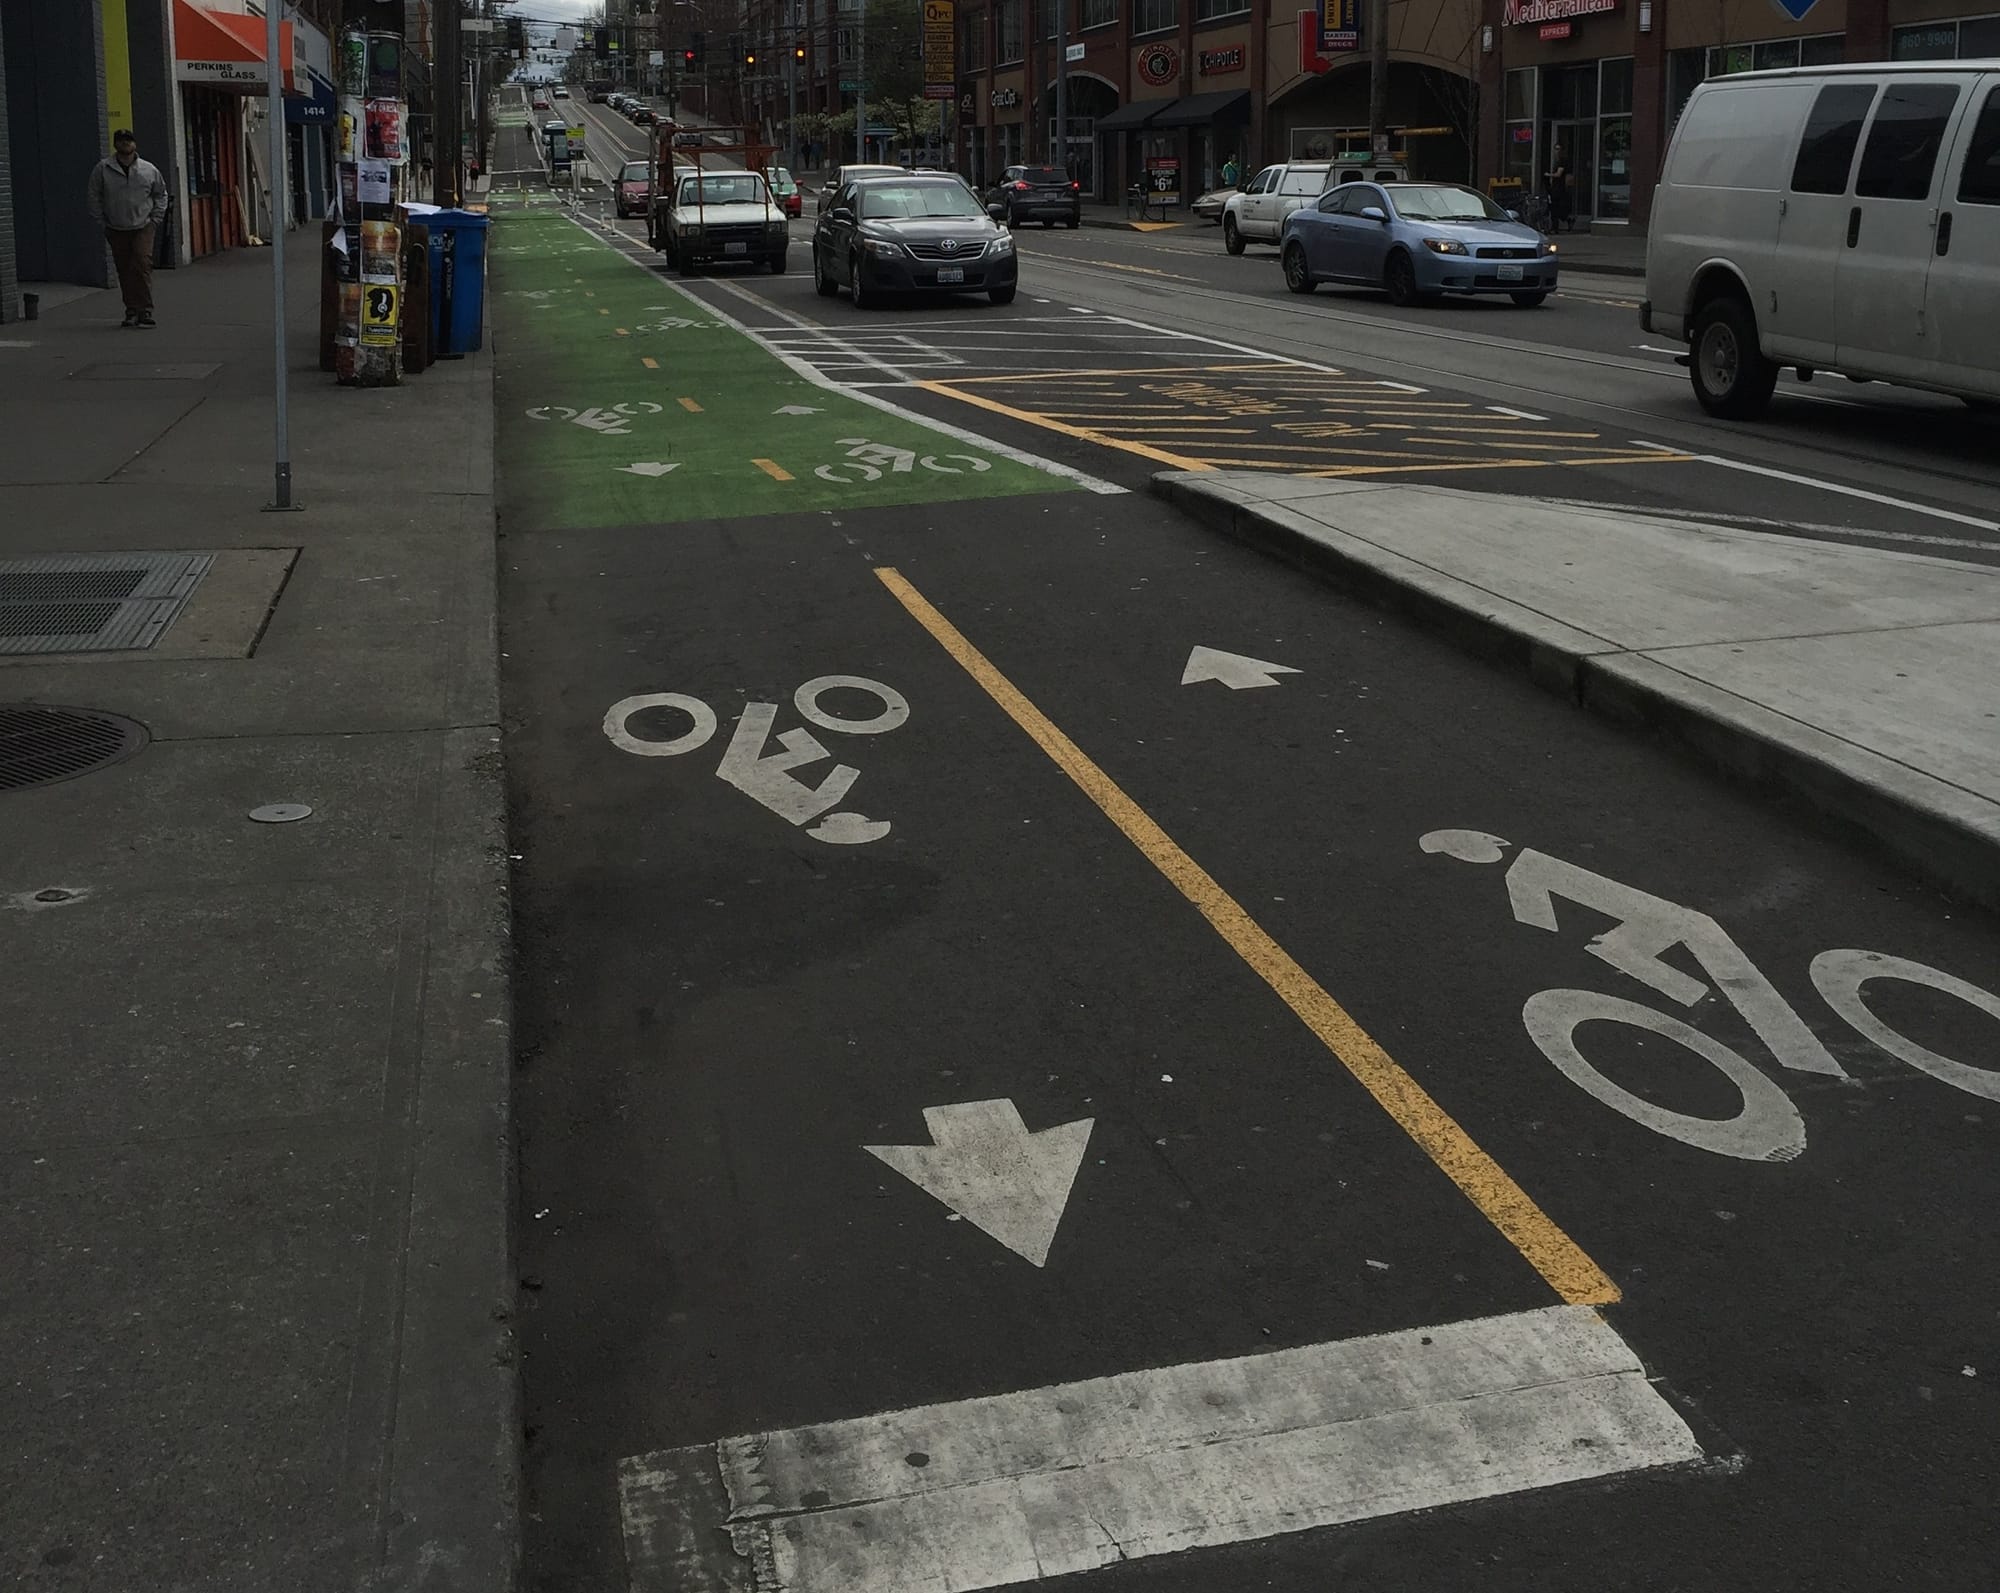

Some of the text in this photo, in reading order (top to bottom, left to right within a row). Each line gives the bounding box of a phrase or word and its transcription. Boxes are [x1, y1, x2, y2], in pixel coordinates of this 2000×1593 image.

[1501, 0, 1615, 27] Mediterranean
[1540, 26, 1569, 38] EXPRESS
[1204, 49, 1240, 69] CHIPOTLE
[187, 62, 233, 71] PERKINS
[221, 71, 256, 80] GLASS
[303, 106, 326, 116] 1414
